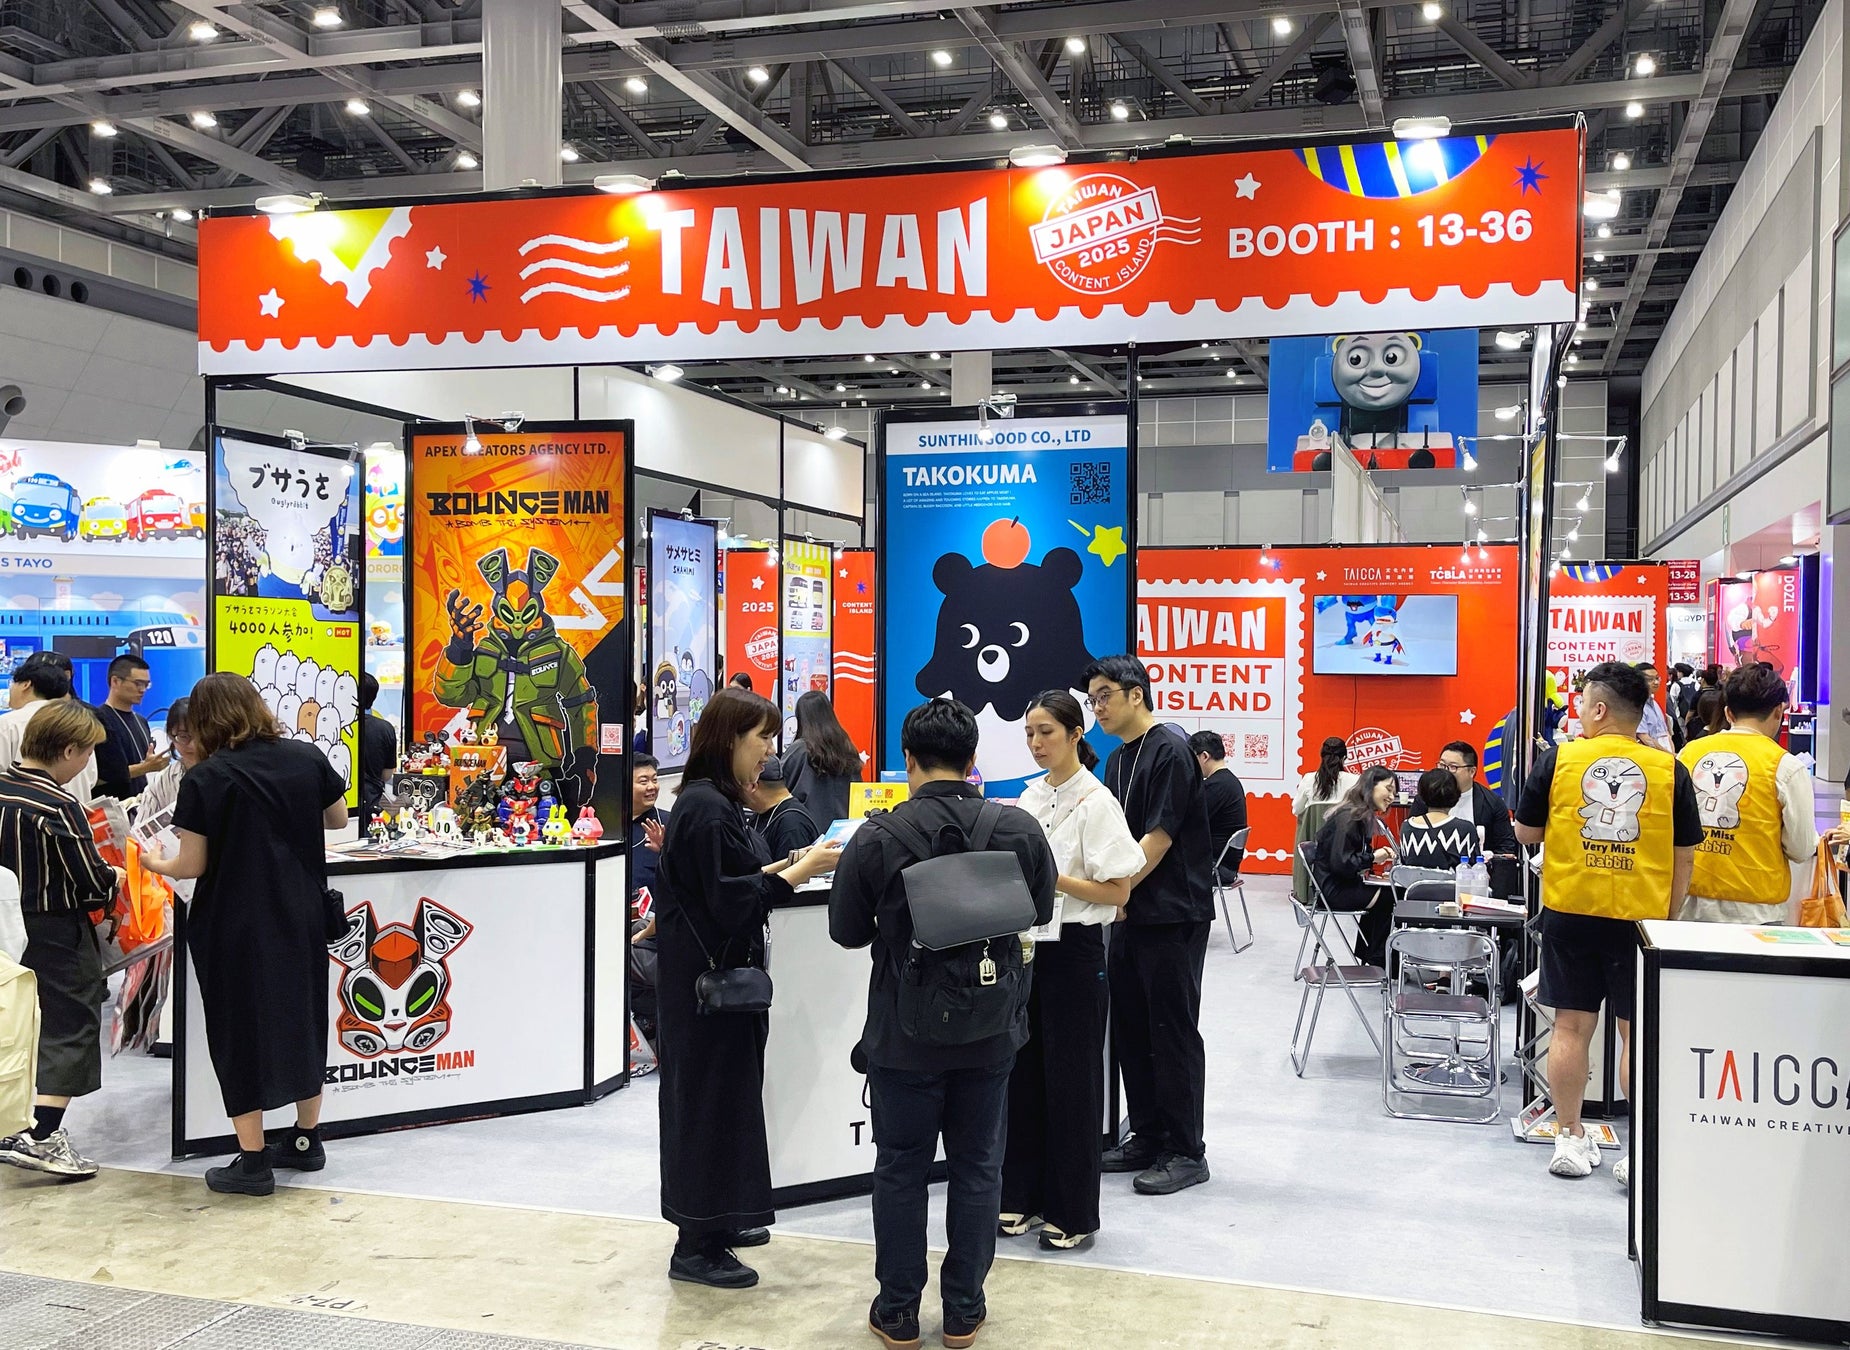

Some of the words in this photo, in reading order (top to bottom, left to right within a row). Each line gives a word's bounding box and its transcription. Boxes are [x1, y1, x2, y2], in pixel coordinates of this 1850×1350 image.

[1056, 183, 1123, 214] TAIWAN
[1050, 201, 1144, 248] JAPAN
[1229, 219, 1374, 259] BOOTH
[1417, 209, 1533, 247] 13-36
[648, 197, 987, 310] TAIWAN
[1078, 238, 1131, 268] 2025
[1055, 260, 1111, 289] CONTENT
[1116, 238, 1150, 282] ISLAND
[1031, 430, 1062, 446] CO.,
[1065, 429, 1091, 443] LTD
[425, 446, 457, 457] APEX
[530, 443, 580, 455] AGENCY
[583, 442, 611, 455] LTD.
[249, 463, 330, 500] ブサうさ
[902, 463, 1038, 486] TAKOKUMA
[426, 490, 560, 516] BOUNCE
[564, 490, 609, 514] MAN
[14, 558, 53, 568] TAYO
[665, 544, 701, 563] サメサヒミ
[1343, 567, 1382, 581] TAICCA
[1429, 568, 1466, 580] TCBLA
[1670, 571, 1696, 579] 13-28
[1669, 592, 1696, 601] 13-36
[1783, 575, 1795, 613] DOZLE
[741, 601, 774, 613] 2025
[1549, 608, 1642, 633] TAIWAN
[147, 631, 173, 645] 120
[1548, 641, 1616, 650] CONTENT
[1563, 653, 1616, 663] ISLAND
[1157, 690, 1272, 712] ISLAND
[1351, 732, 1384, 745] TAIWAN
[1347, 742, 1394, 761] JAPAN
[1711, 829, 1735, 841] Miss
[1582, 841, 1608, 854] Very
[1610, 843, 1636, 855] Miss
[1586, 854, 1634, 870] Rabbit
[1689, 1047, 1850, 1110] TAICC
[1689, 1113, 1756, 1128] TAIWAN
[1767, 1119, 1850, 1136] CREATIV
